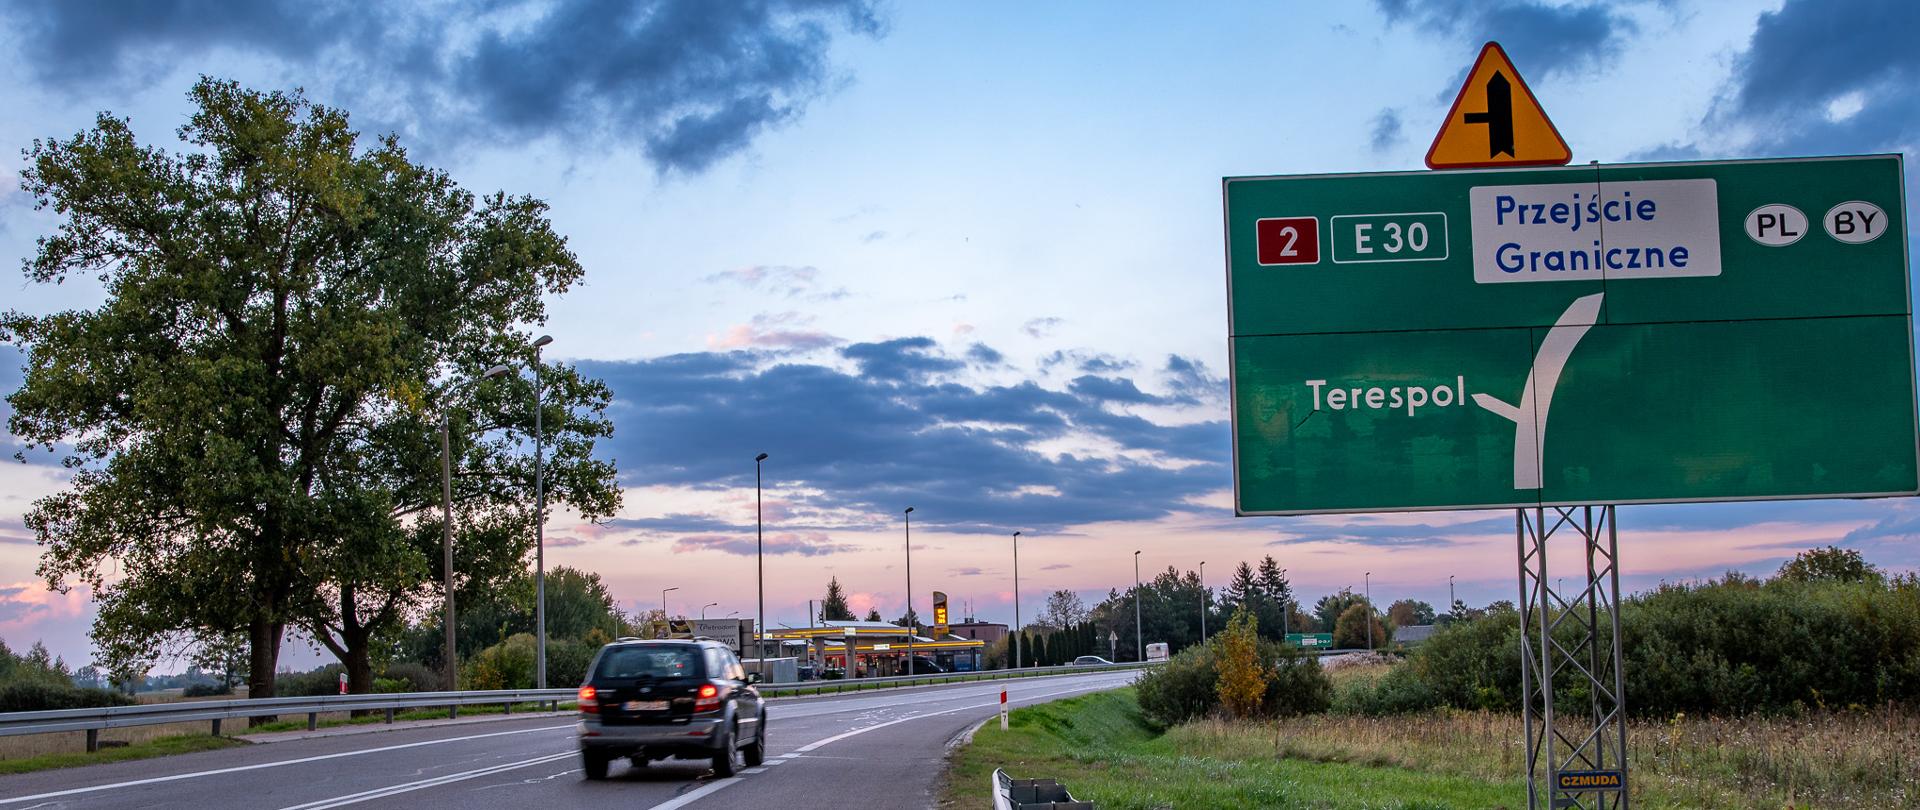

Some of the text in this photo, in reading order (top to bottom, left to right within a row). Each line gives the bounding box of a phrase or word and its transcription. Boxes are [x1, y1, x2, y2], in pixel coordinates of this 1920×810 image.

[1495, 191, 1656, 232] Przejście
[1757, 213, 1798, 237] PL
[1834, 210, 1879, 235] BY
[1279, 226, 1299, 257] 2
[1355, 222, 1429, 254] E 30
[1495, 240, 1689, 273] Graniczne
[1305, 375, 1465, 417] Terespol
[1561, 775, 1619, 786] CZMUDA
